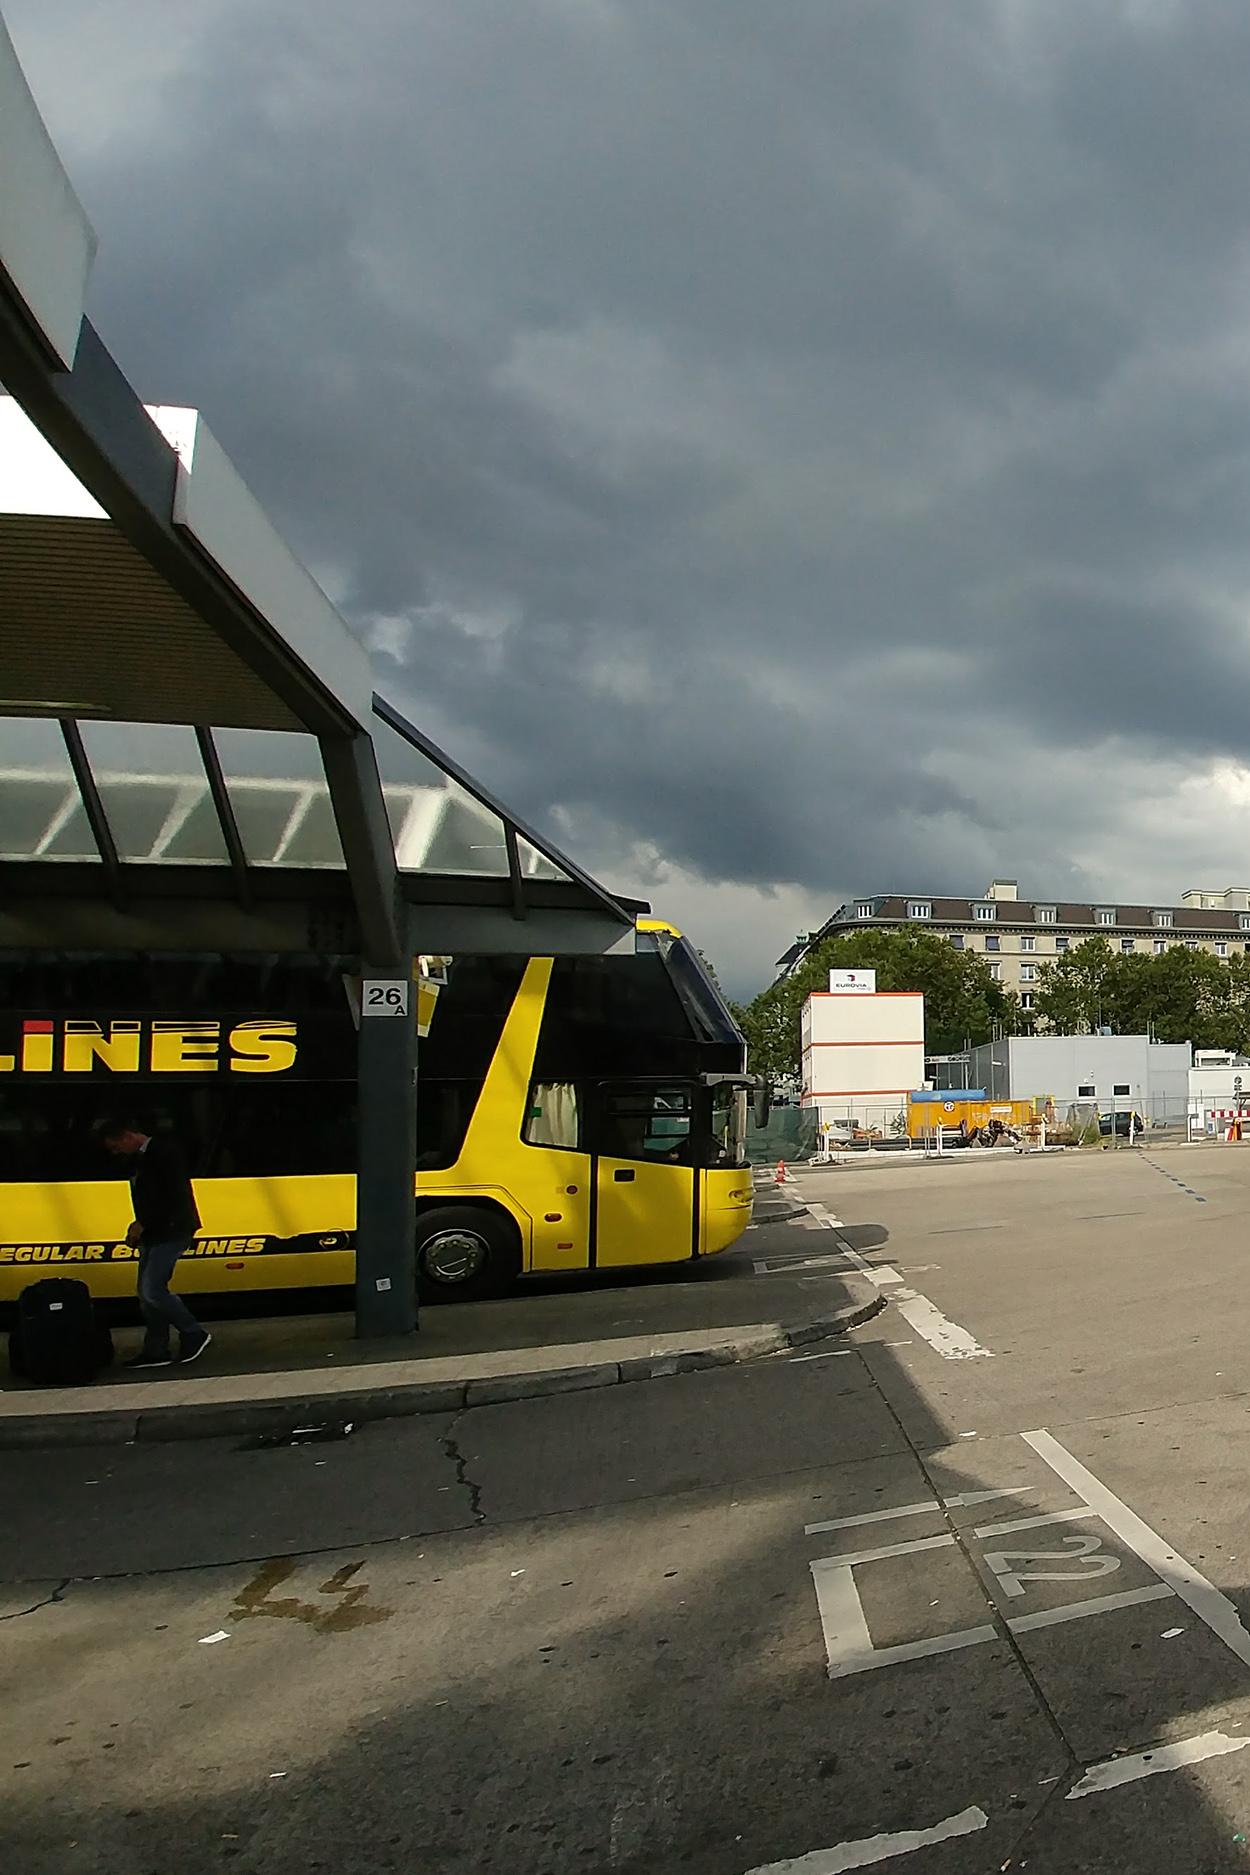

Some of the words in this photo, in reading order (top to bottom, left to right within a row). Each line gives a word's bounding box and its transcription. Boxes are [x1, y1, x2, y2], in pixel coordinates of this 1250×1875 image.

[368, 987, 402, 1006] 26
[394, 1004, 406, 1015] A
[0, 1020, 298, 1072] INES
[0, 1245, 105, 1262] EGULAR
[983, 1535, 1121, 1598] 22
